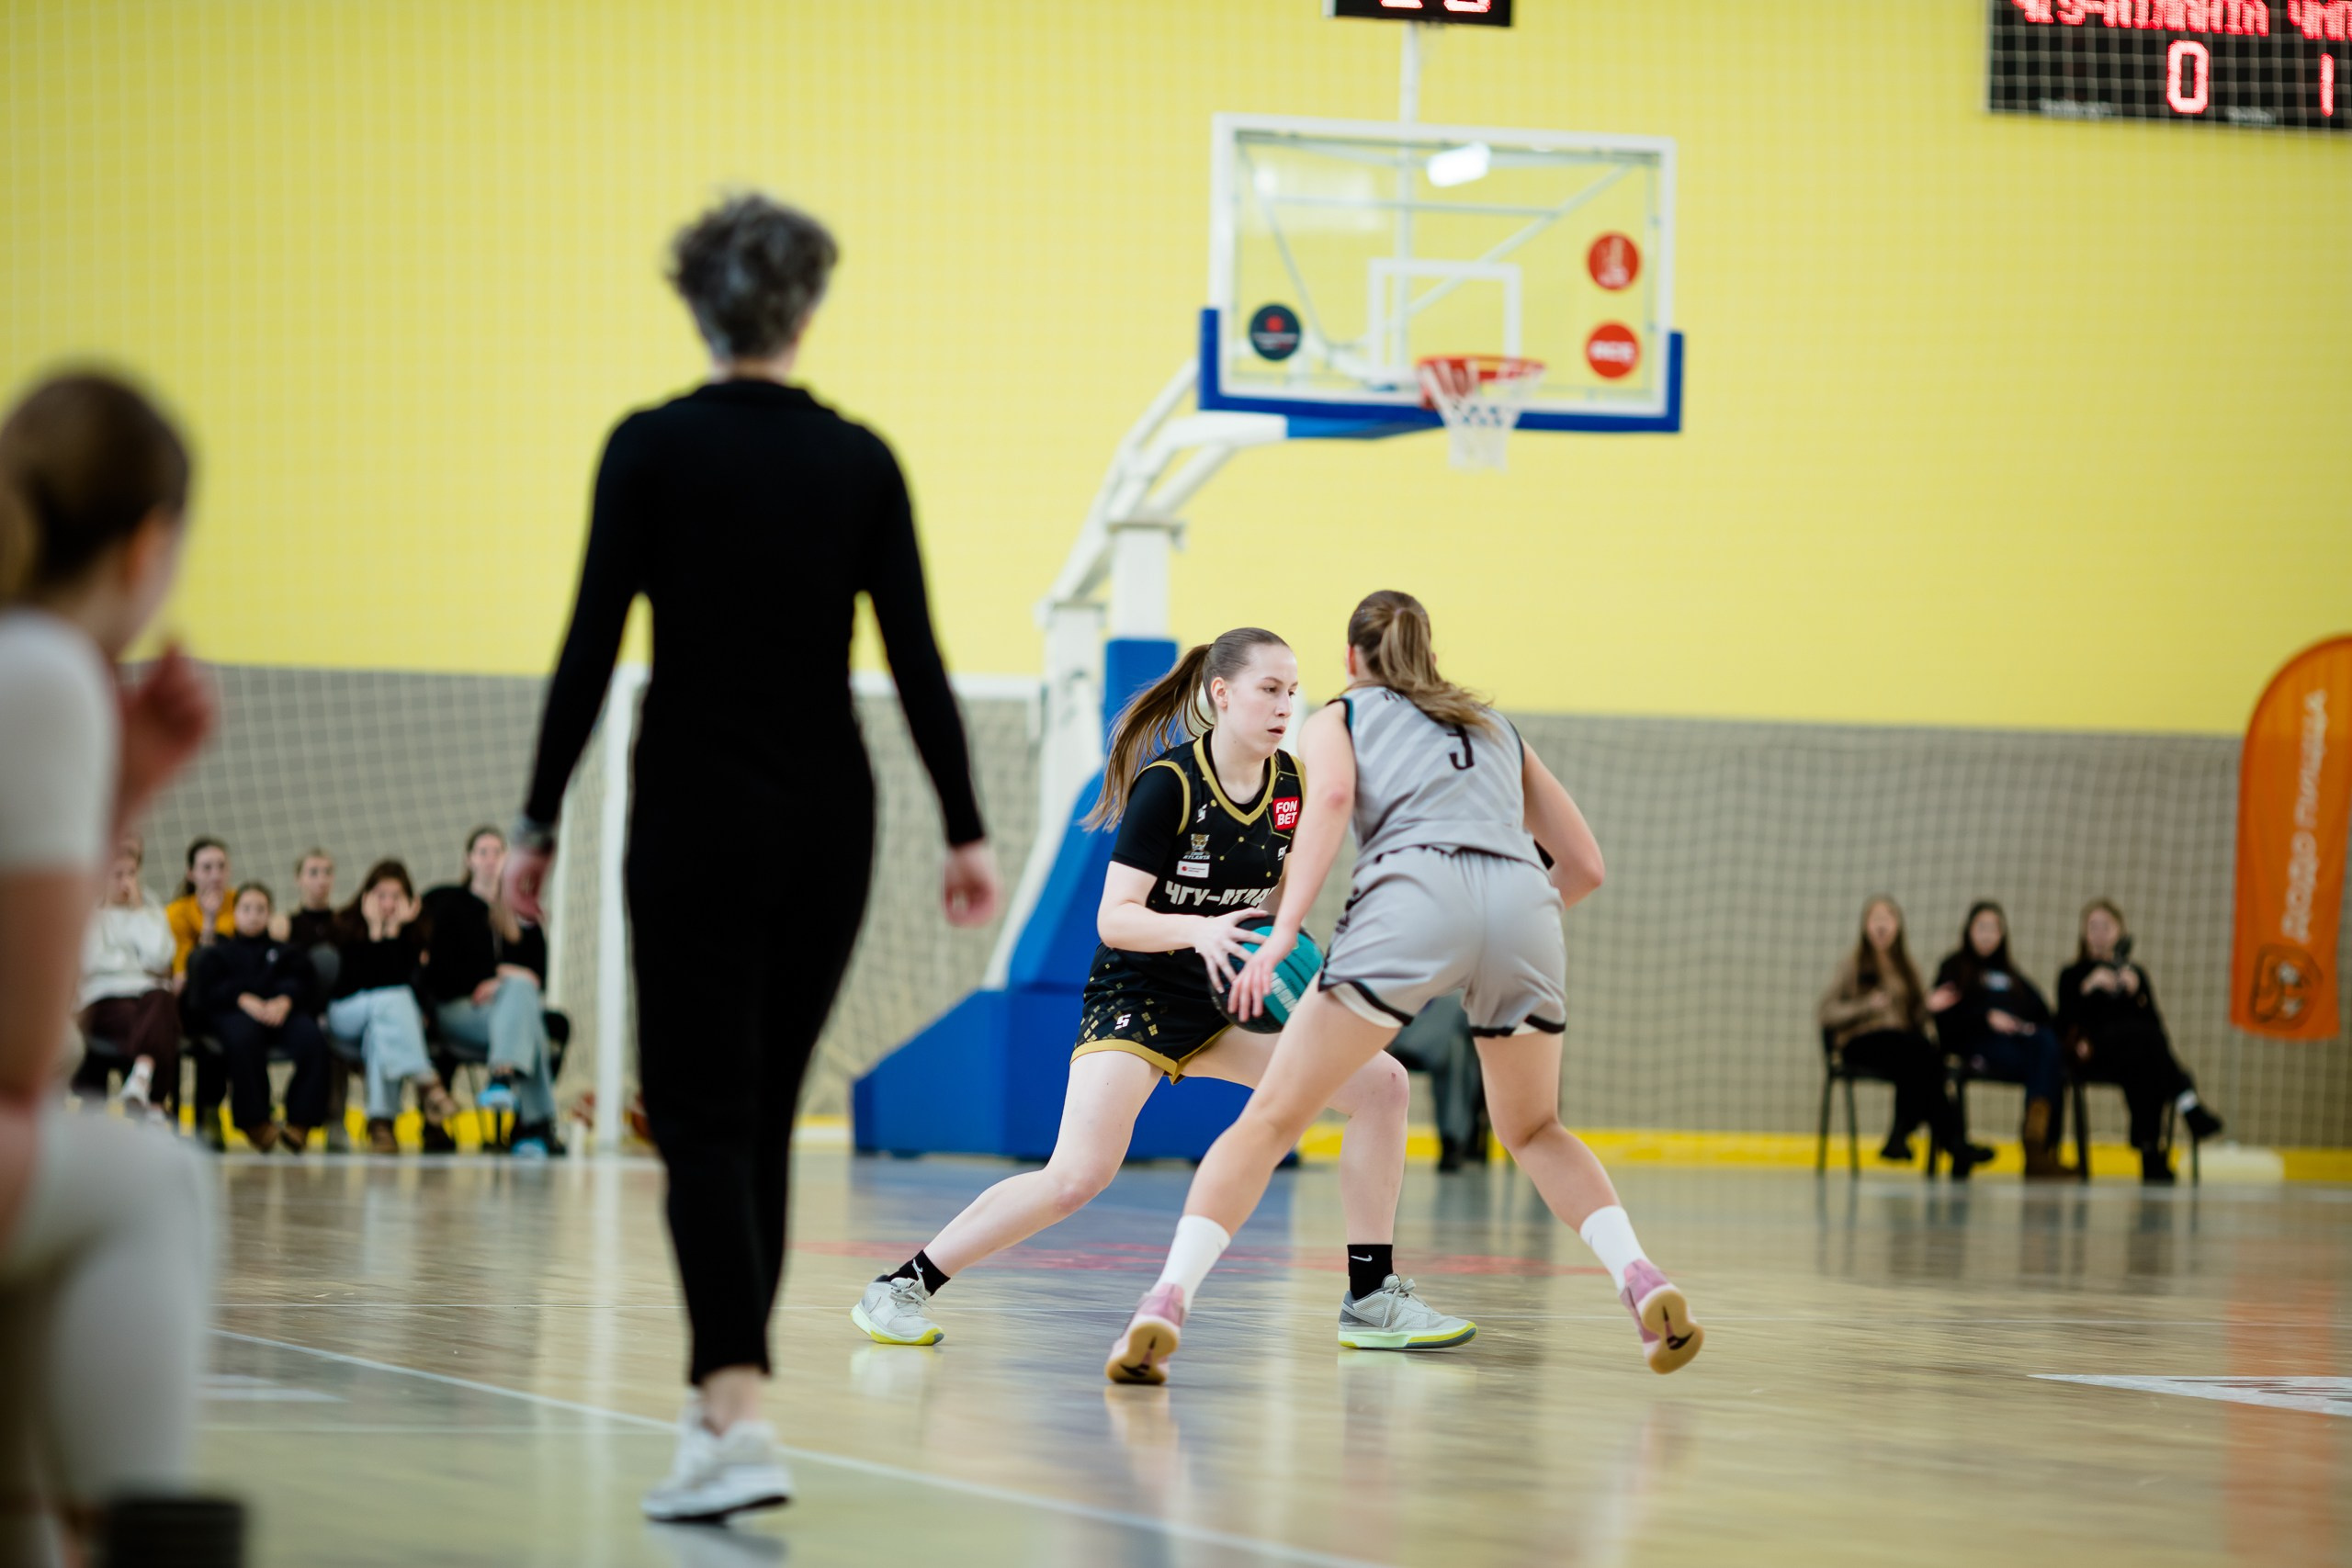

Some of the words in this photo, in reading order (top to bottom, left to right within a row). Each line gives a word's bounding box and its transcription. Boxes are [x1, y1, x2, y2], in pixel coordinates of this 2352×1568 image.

[2166, 39, 2210, 114] 0
[1275, 799, 1298, 814] FON
[1277, 811, 1298, 826] BET
[1165, 881, 1273, 907] ЧГУ-АТЛА
